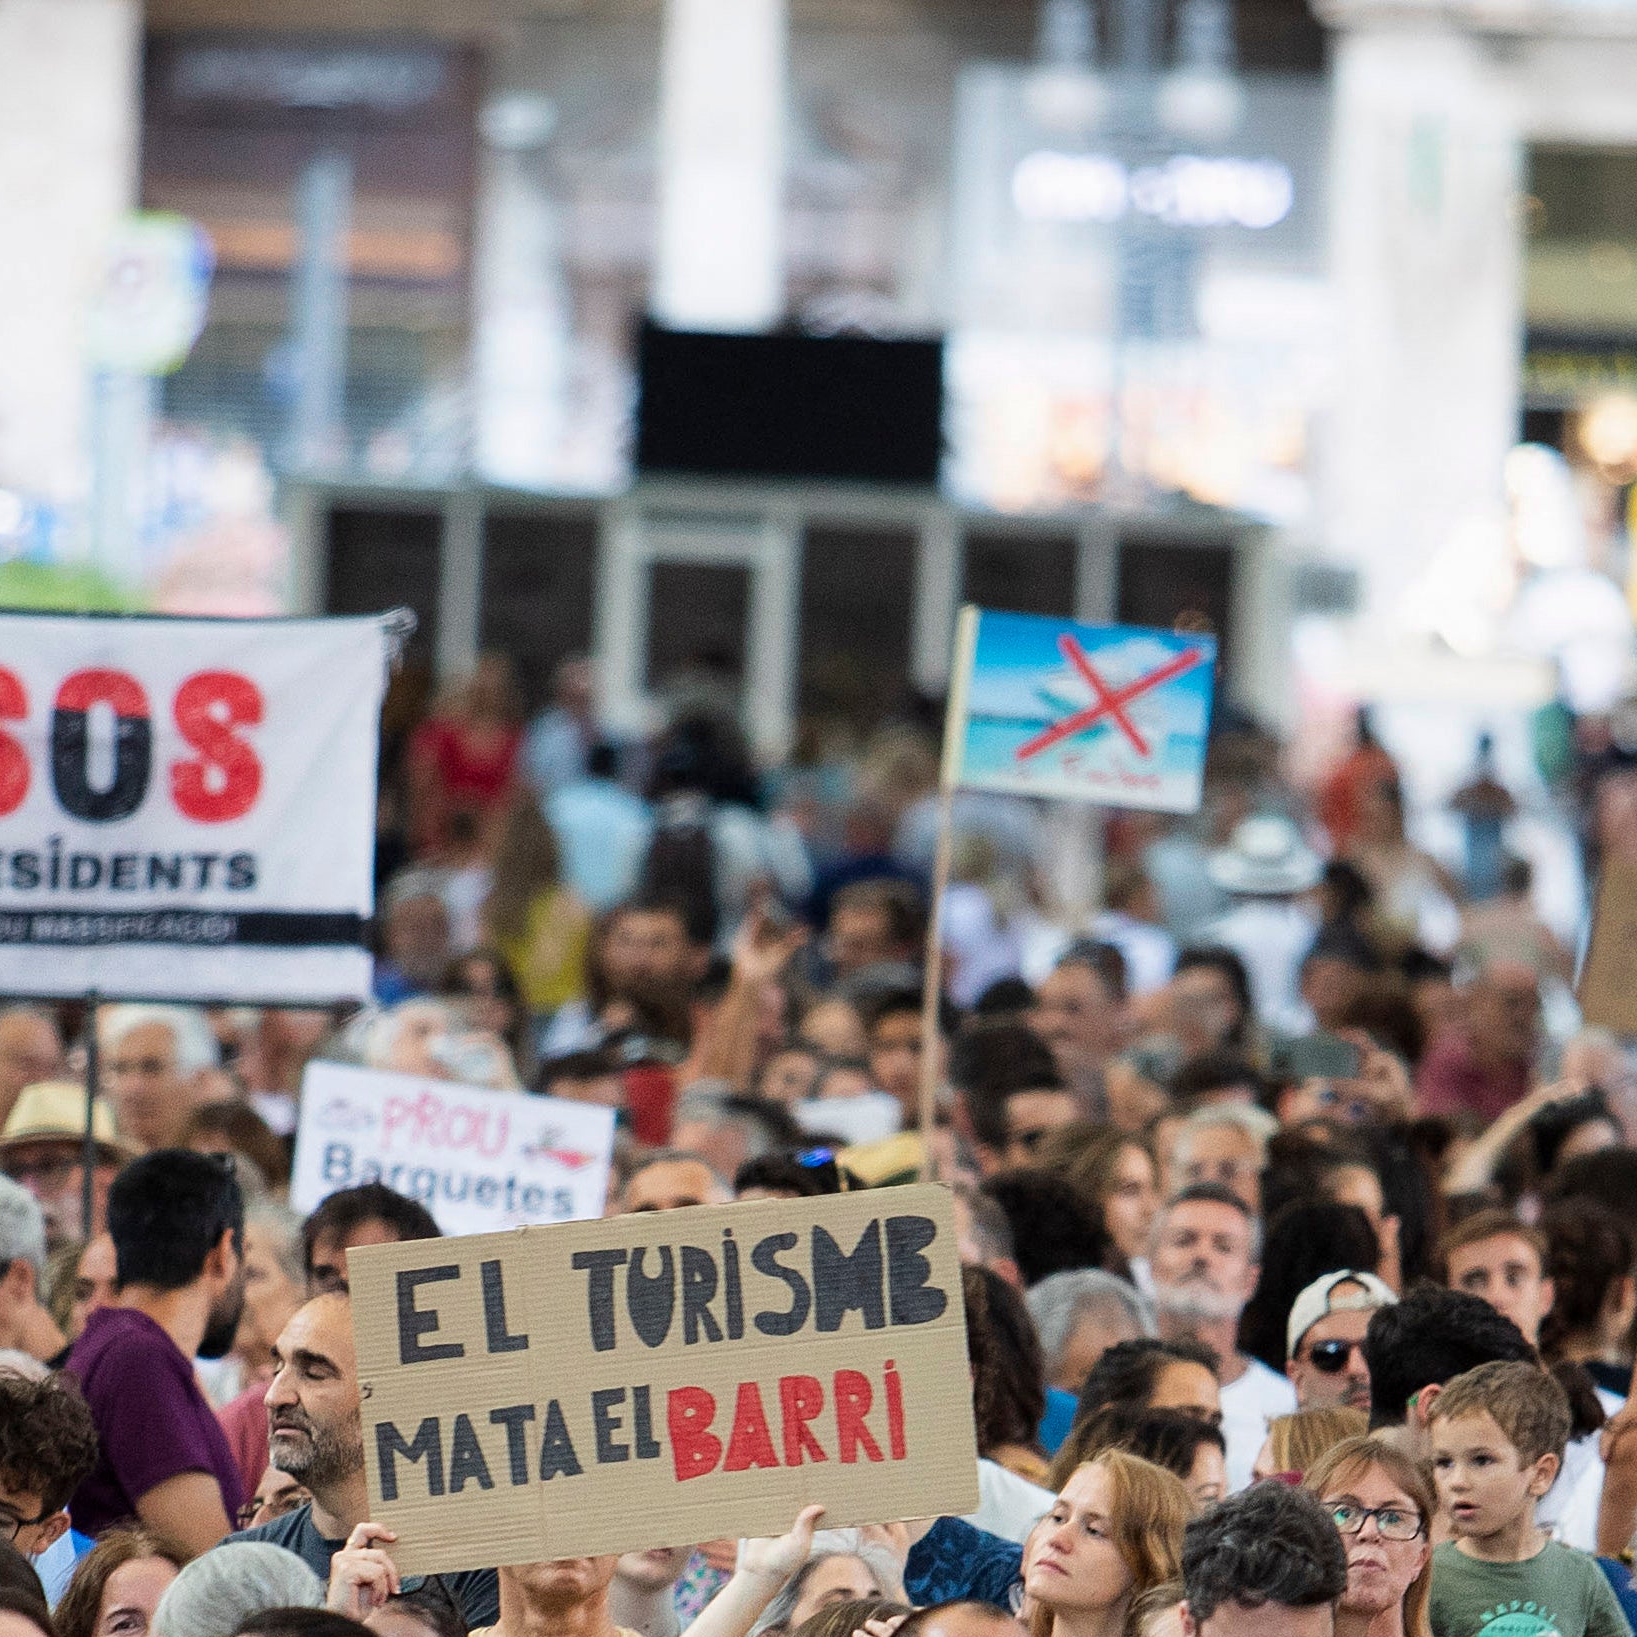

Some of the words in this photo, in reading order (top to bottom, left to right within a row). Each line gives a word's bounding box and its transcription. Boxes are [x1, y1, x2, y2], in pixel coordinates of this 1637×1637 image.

[394, 1259, 529, 1366] EL
[374, 1399, 584, 1501] MATA
[590, 1384, 662, 1465] EL
